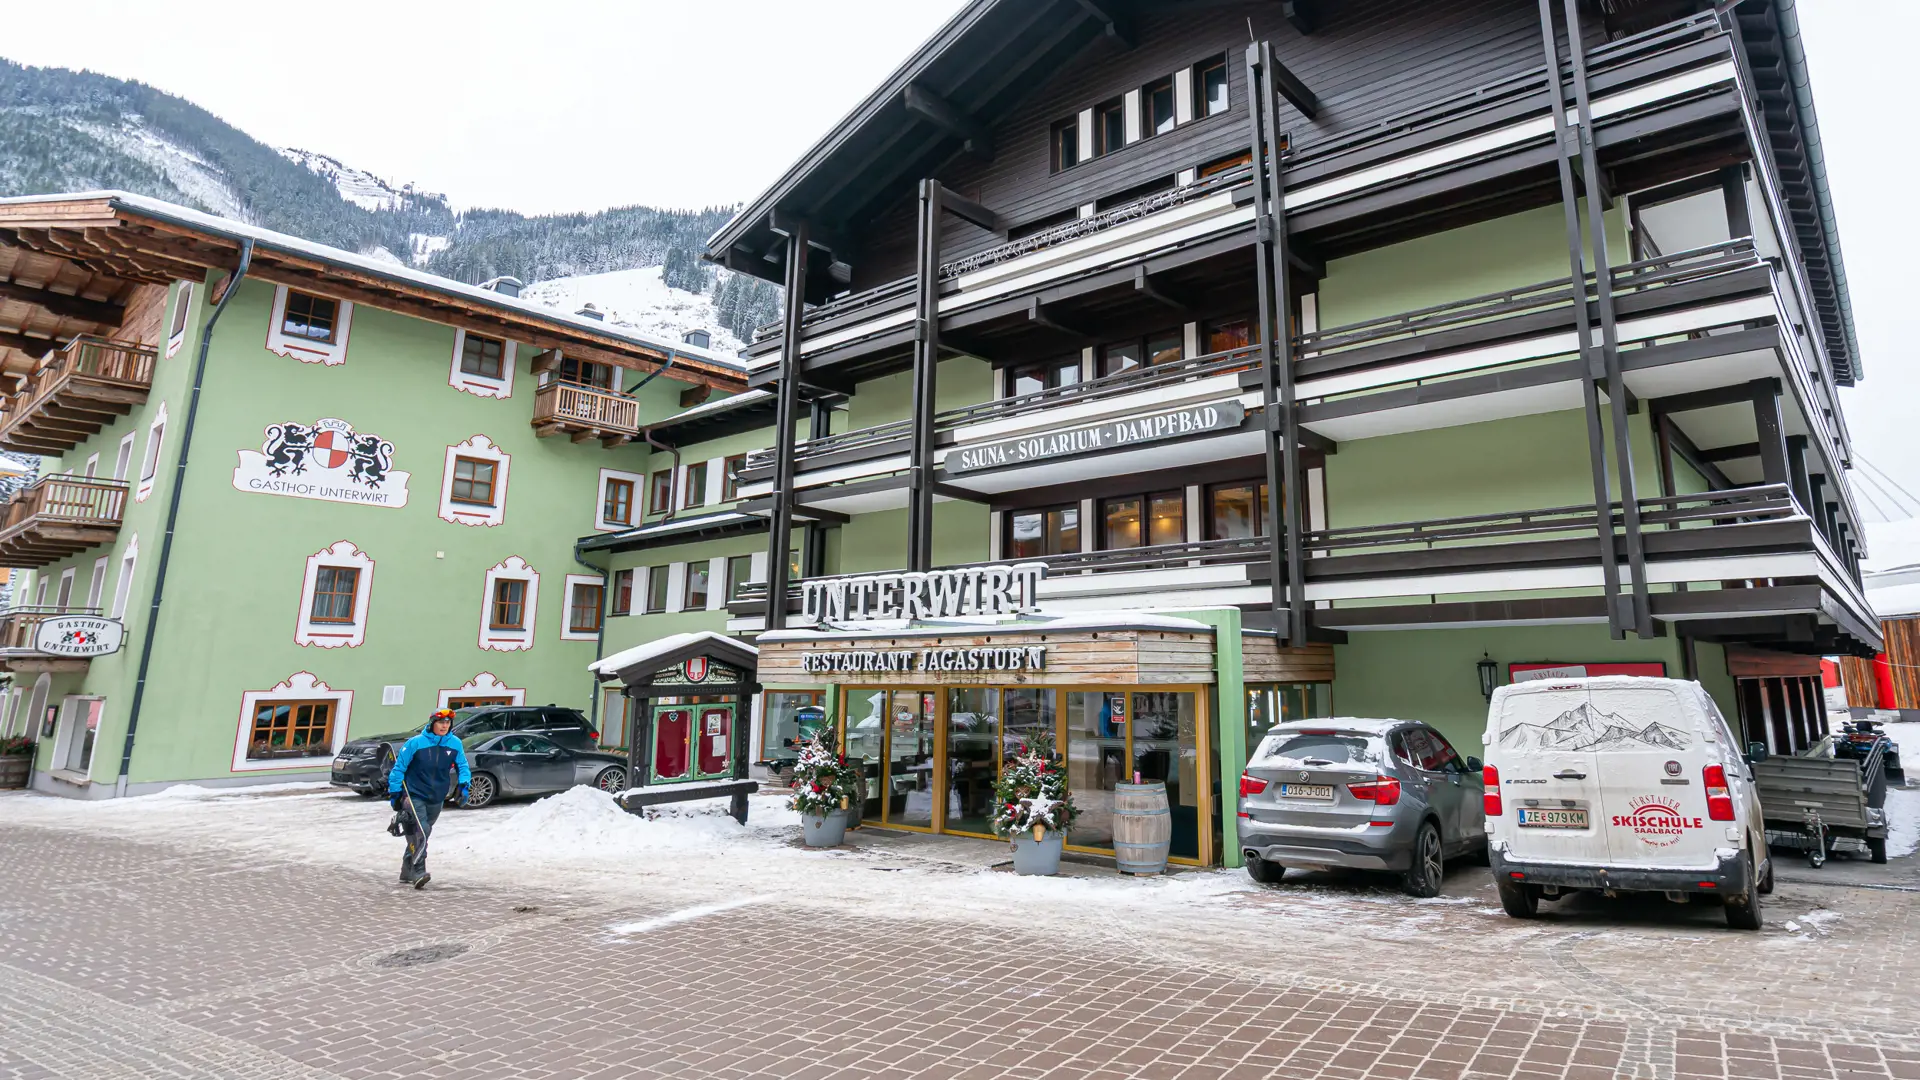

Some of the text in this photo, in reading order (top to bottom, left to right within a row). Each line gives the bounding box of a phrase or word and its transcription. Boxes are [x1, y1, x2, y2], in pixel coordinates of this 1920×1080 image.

[961, 406, 1218, 469] SAUNA SOLARIUM DAMPFBAD
[249, 478, 389, 503] GASTHOF UNTERWIRT
[802, 565, 1046, 624] UNTERWIRT
[57, 620, 108, 630] GASTHOF
[43, 641, 110, 653] UNTERWIRT
[801, 647, 1043, 672] RESTAURANT JAGASTUB'N
[1628, 794, 1681, 810] FÜRSTAUER
[1527, 811, 1540, 823] ZE
[1612, 815, 1703, 829] SKISCHULE
[1634, 827, 1683, 835] SAALBACH
